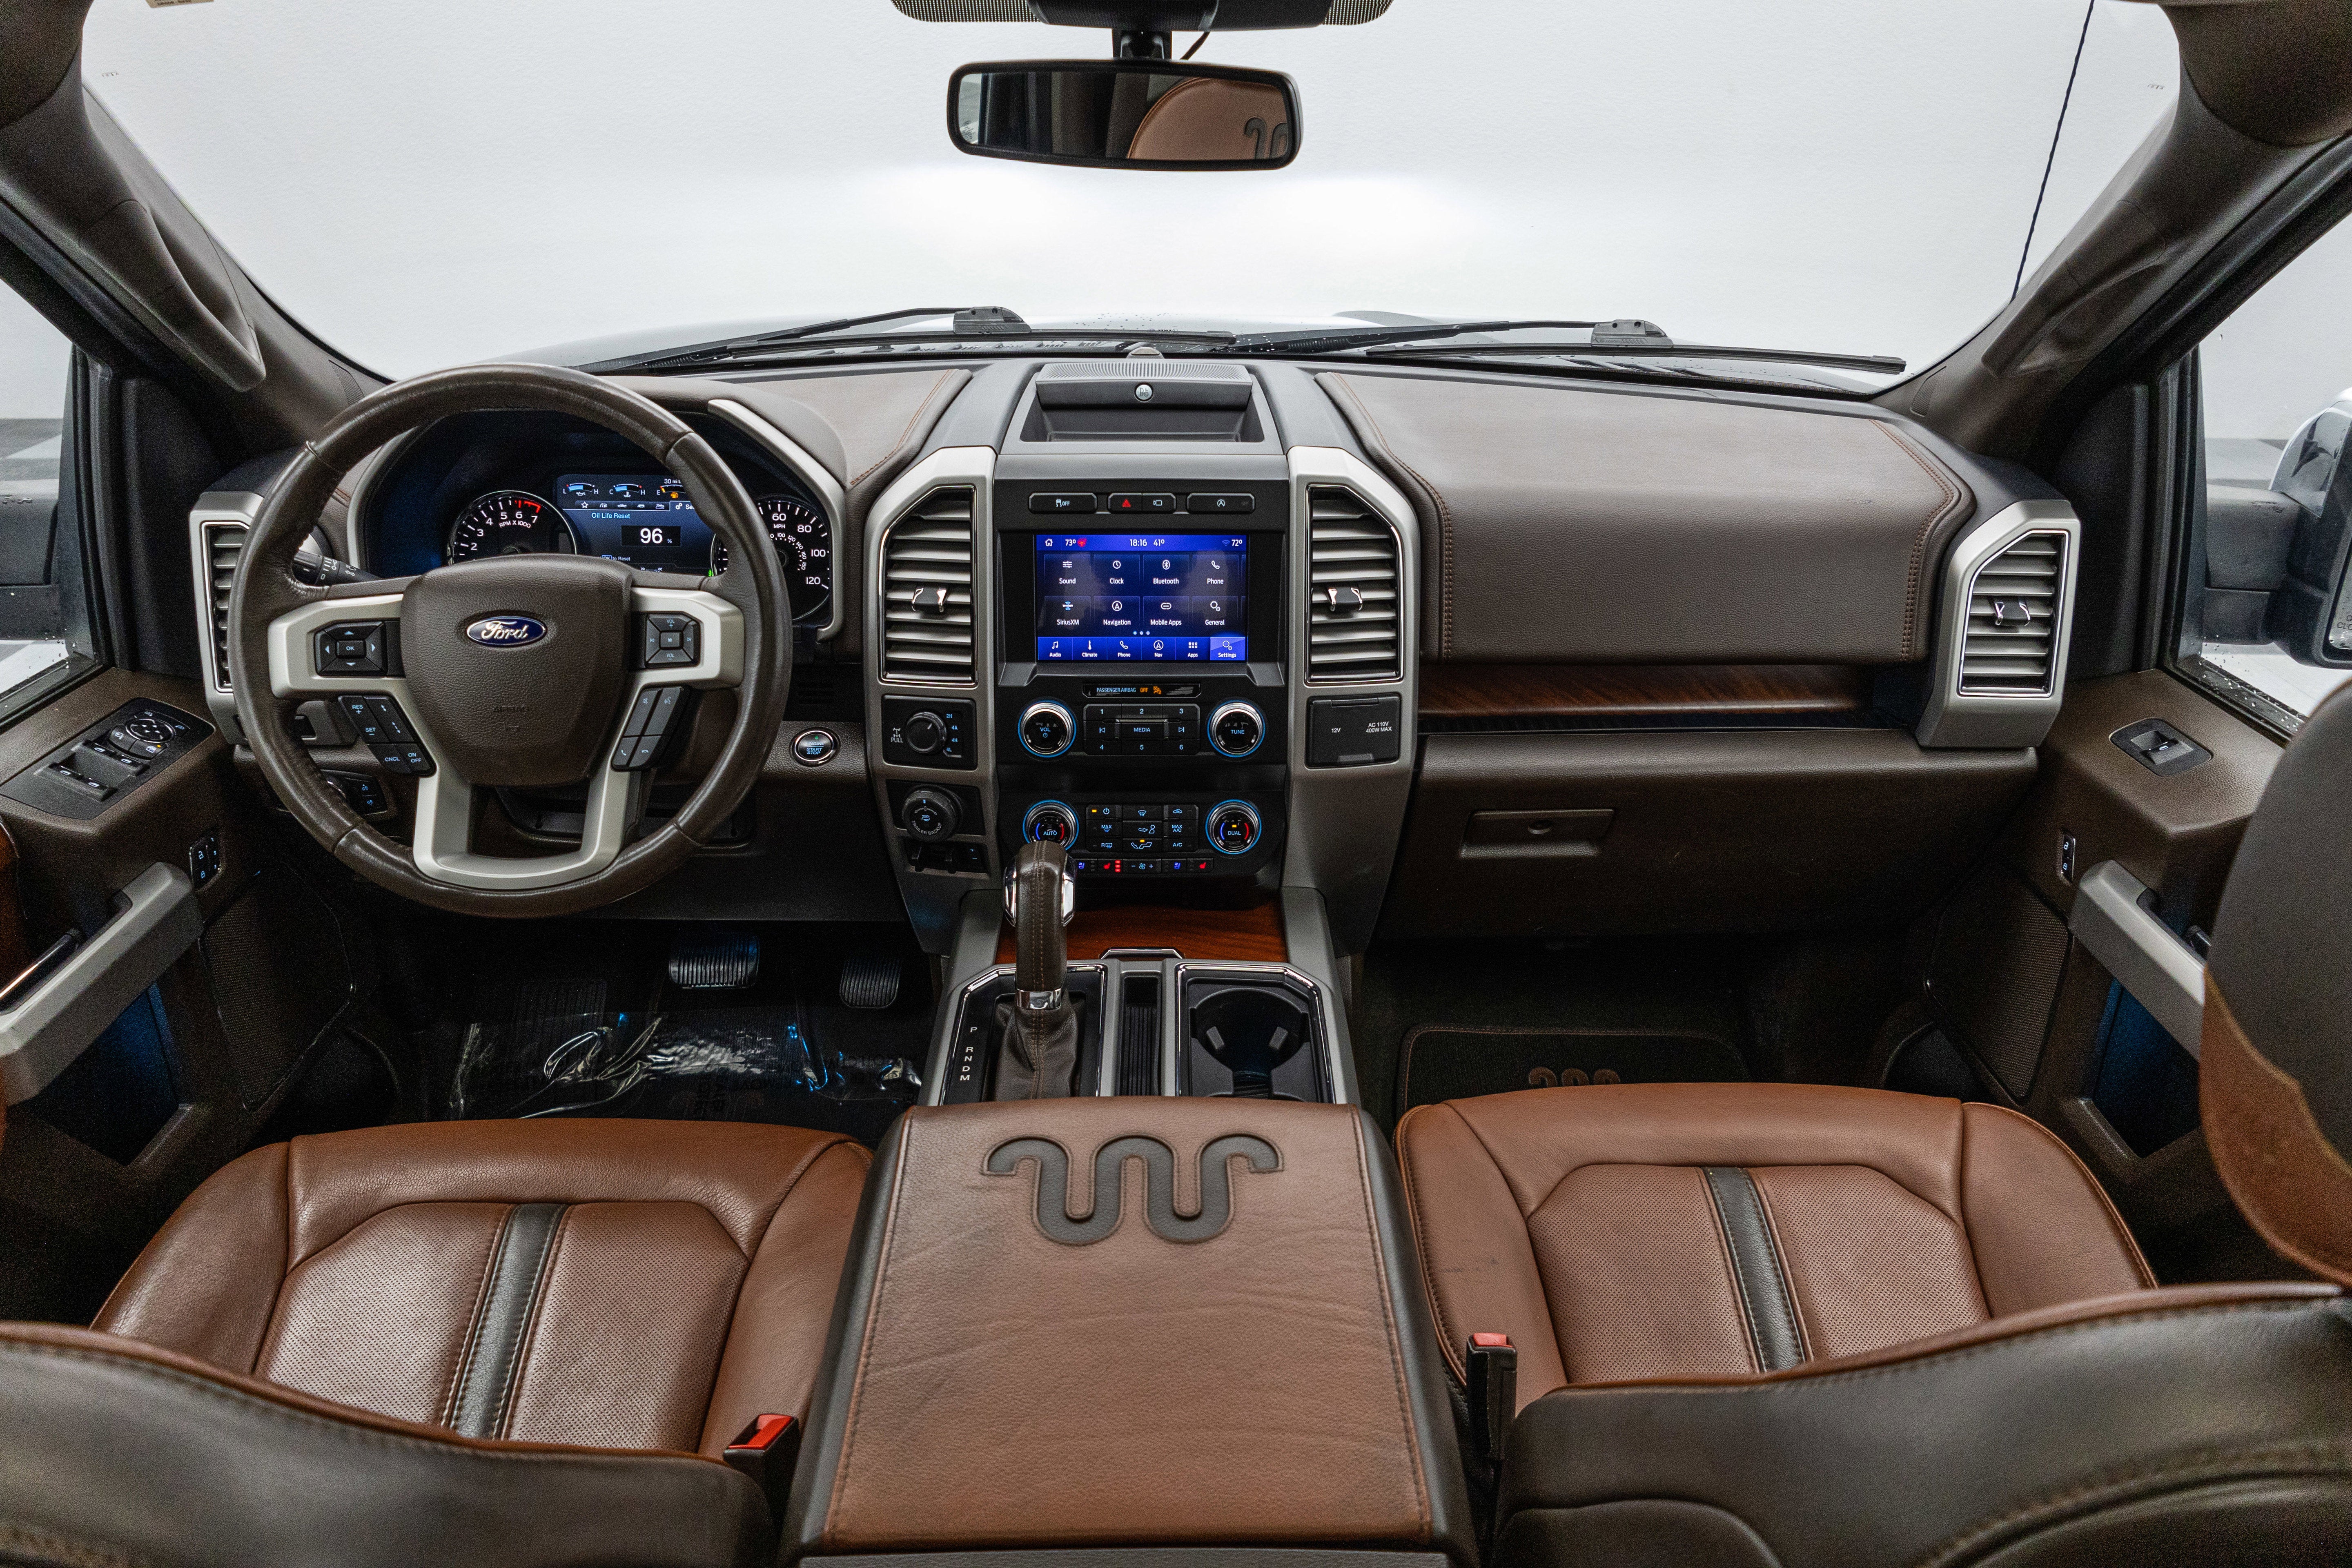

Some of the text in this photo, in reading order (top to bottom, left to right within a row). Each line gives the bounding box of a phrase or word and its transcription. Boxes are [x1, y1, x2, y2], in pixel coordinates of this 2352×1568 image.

[500, 512, 508, 520] 5
[772, 513, 786, 521] 60
[797, 525, 812, 533] 80
[640, 528, 663, 544] 96
[1129, 539, 1147, 547] 18:16
[811, 549, 826, 557] 100
[805, 577, 821, 585] 120
[481, 620, 530, 640] Ford
[911, 820, 942, 835] TRAILER BACKUP
